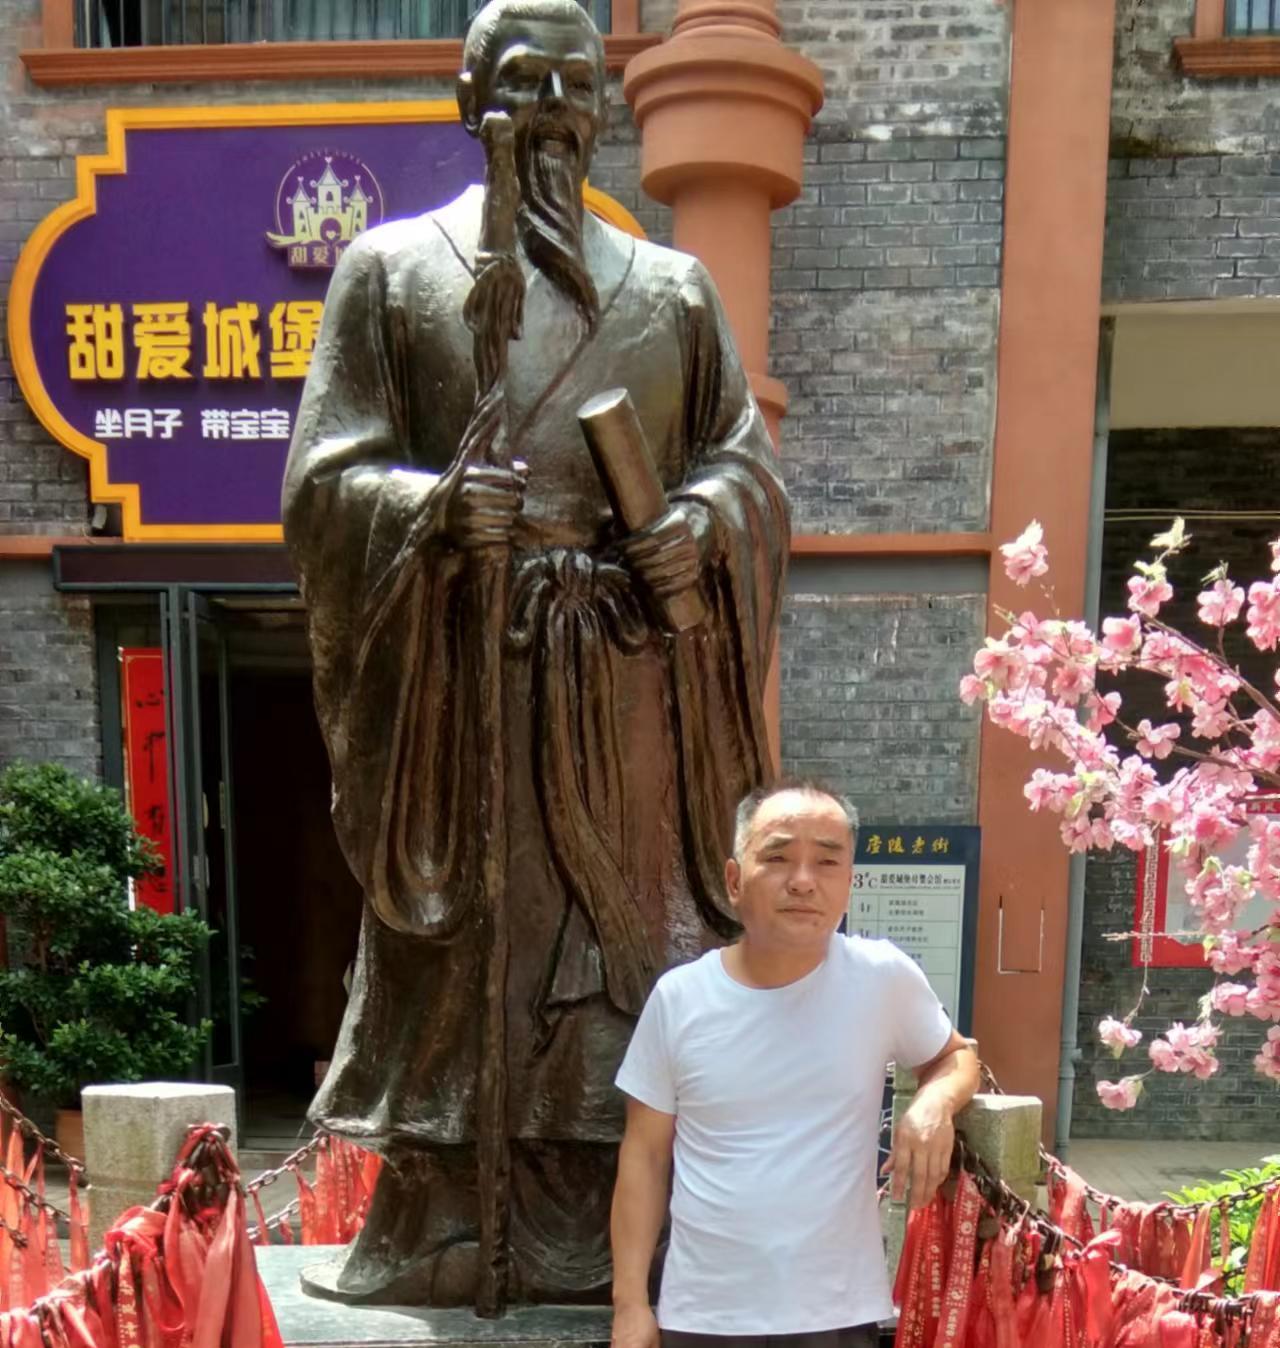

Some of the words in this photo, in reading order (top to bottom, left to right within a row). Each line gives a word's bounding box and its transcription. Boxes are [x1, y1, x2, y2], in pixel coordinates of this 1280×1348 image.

[65, 302, 321, 382] 甜爱城堡
[94, 408, 182, 439] 坐月子
[201, 409, 290, 440] 带宝宝
